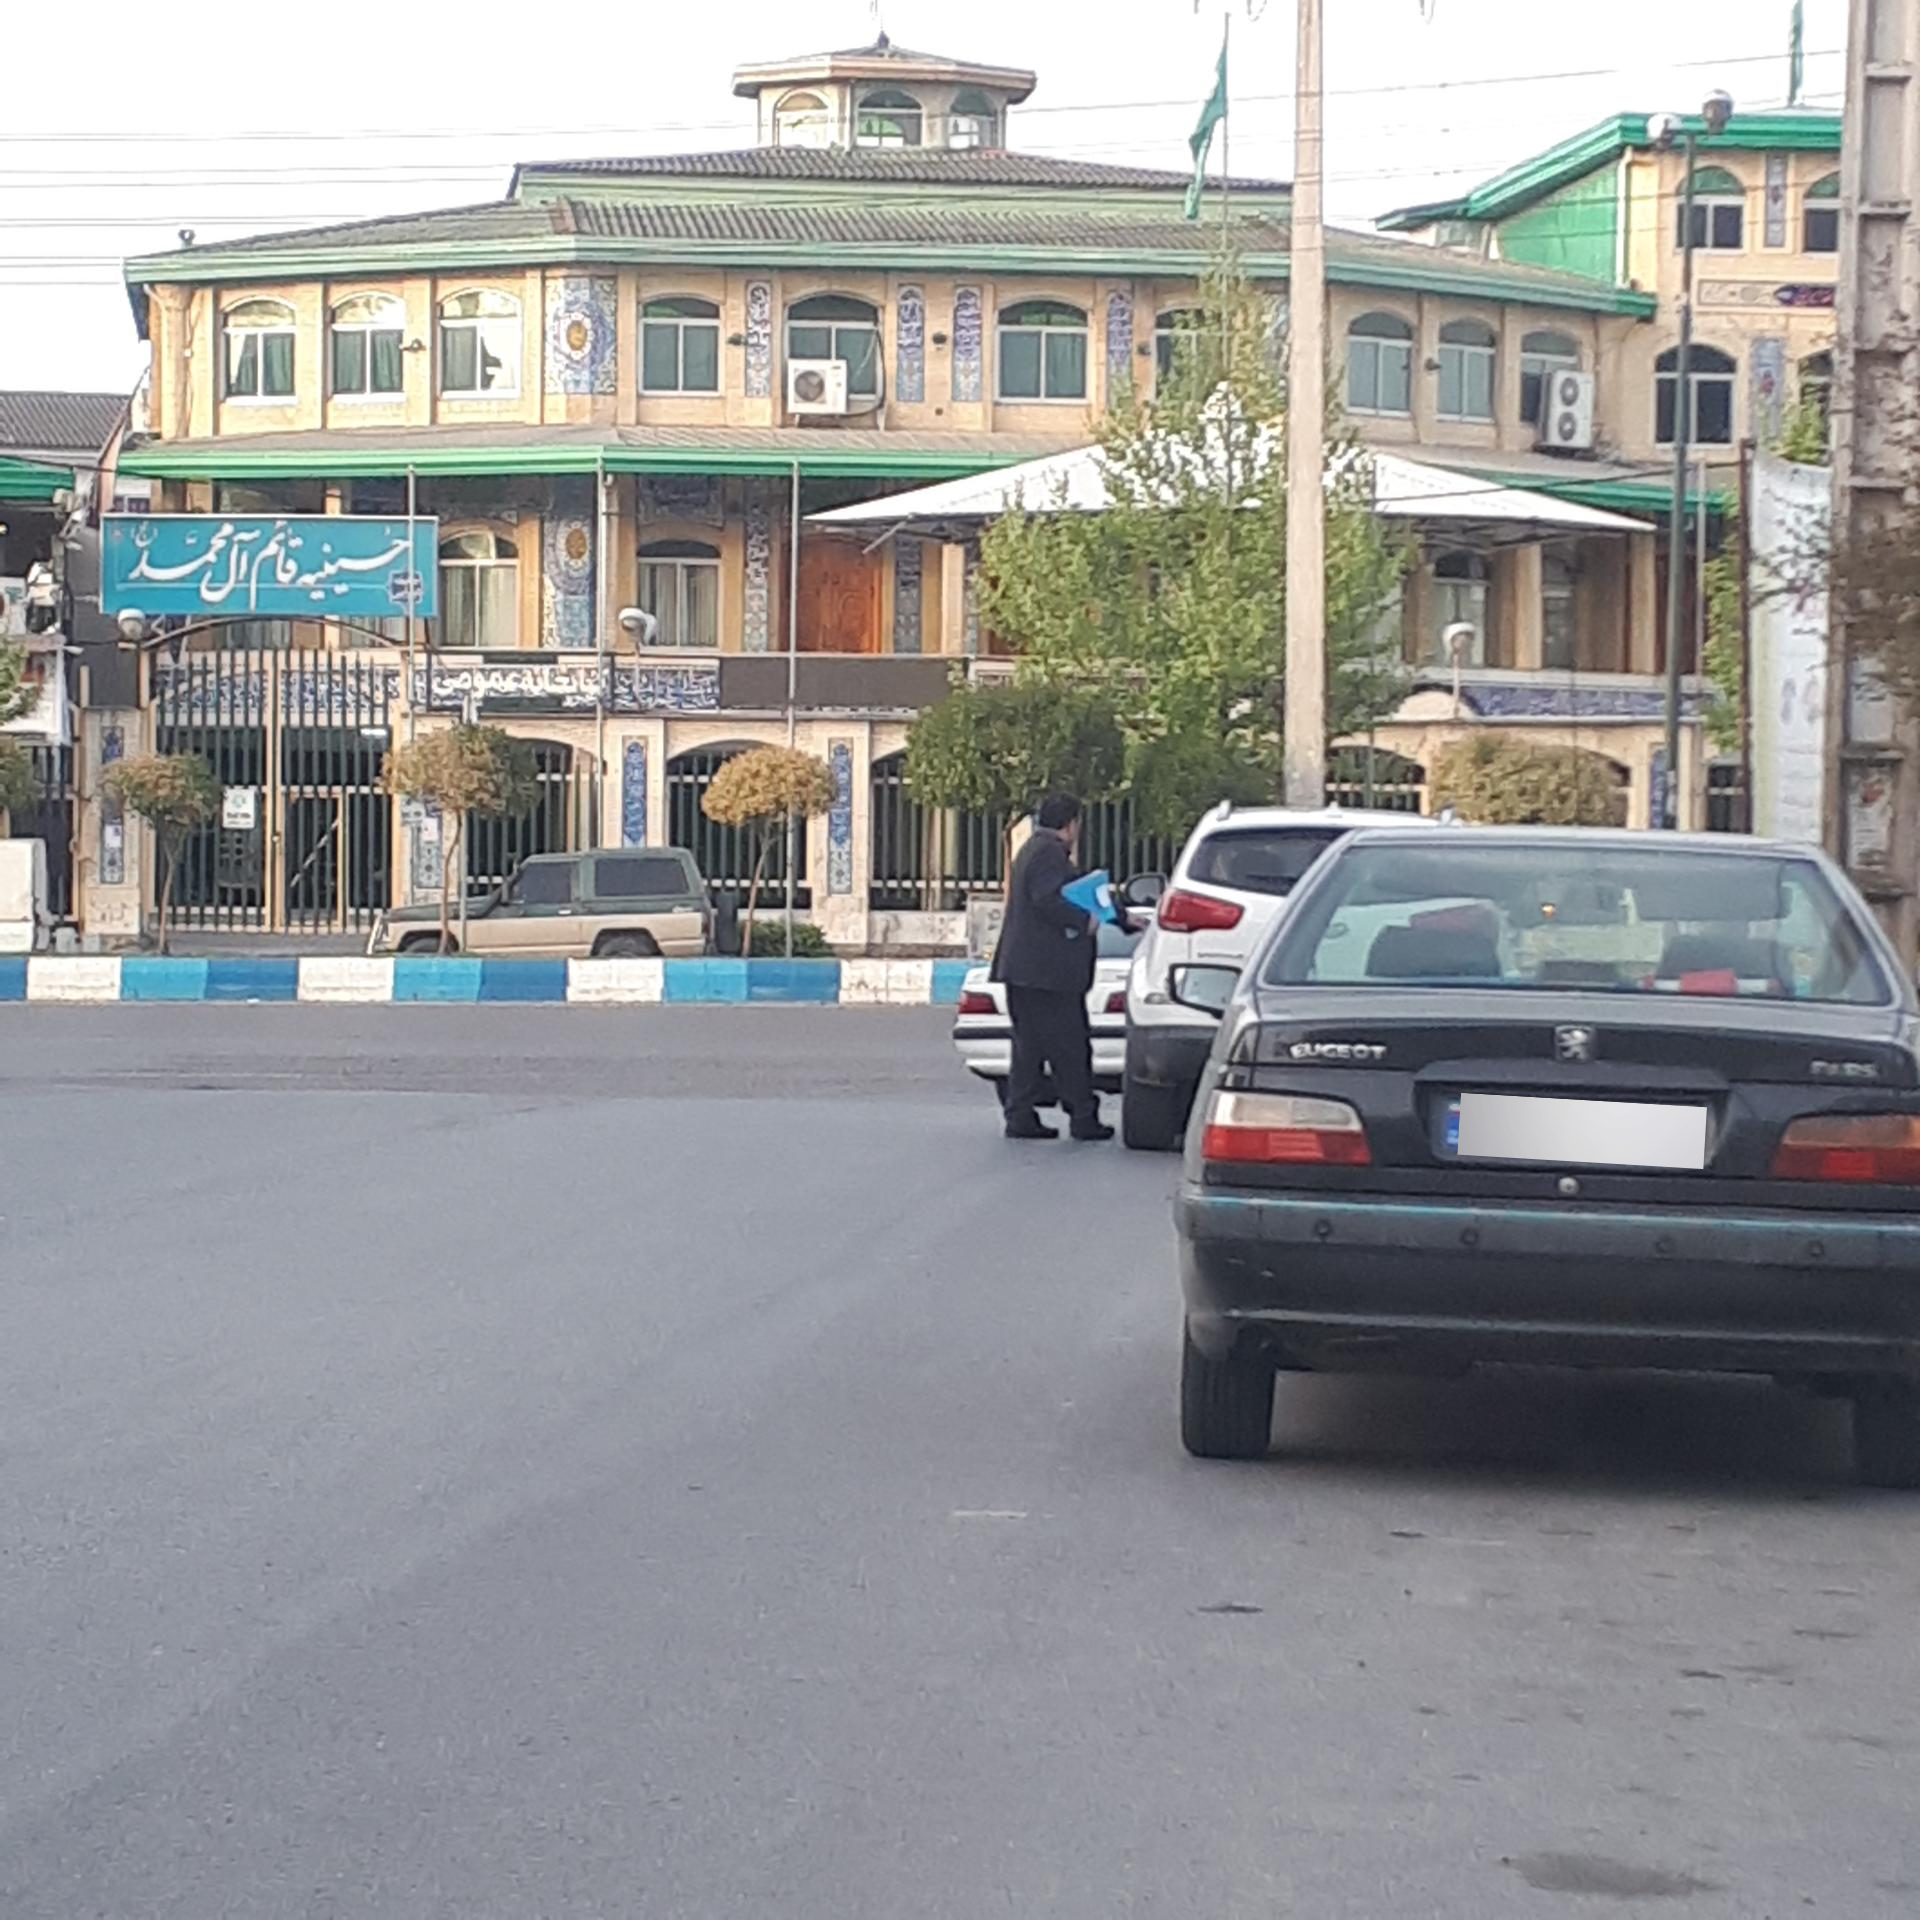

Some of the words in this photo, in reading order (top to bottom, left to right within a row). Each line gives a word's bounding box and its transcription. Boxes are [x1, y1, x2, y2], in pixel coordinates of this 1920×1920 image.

[201, 530, 261, 603] آل
[250, 520, 303, 611] قائم
[296, 526, 411, 599] حسینیه
[432, 670, 521, 699] عمومی
